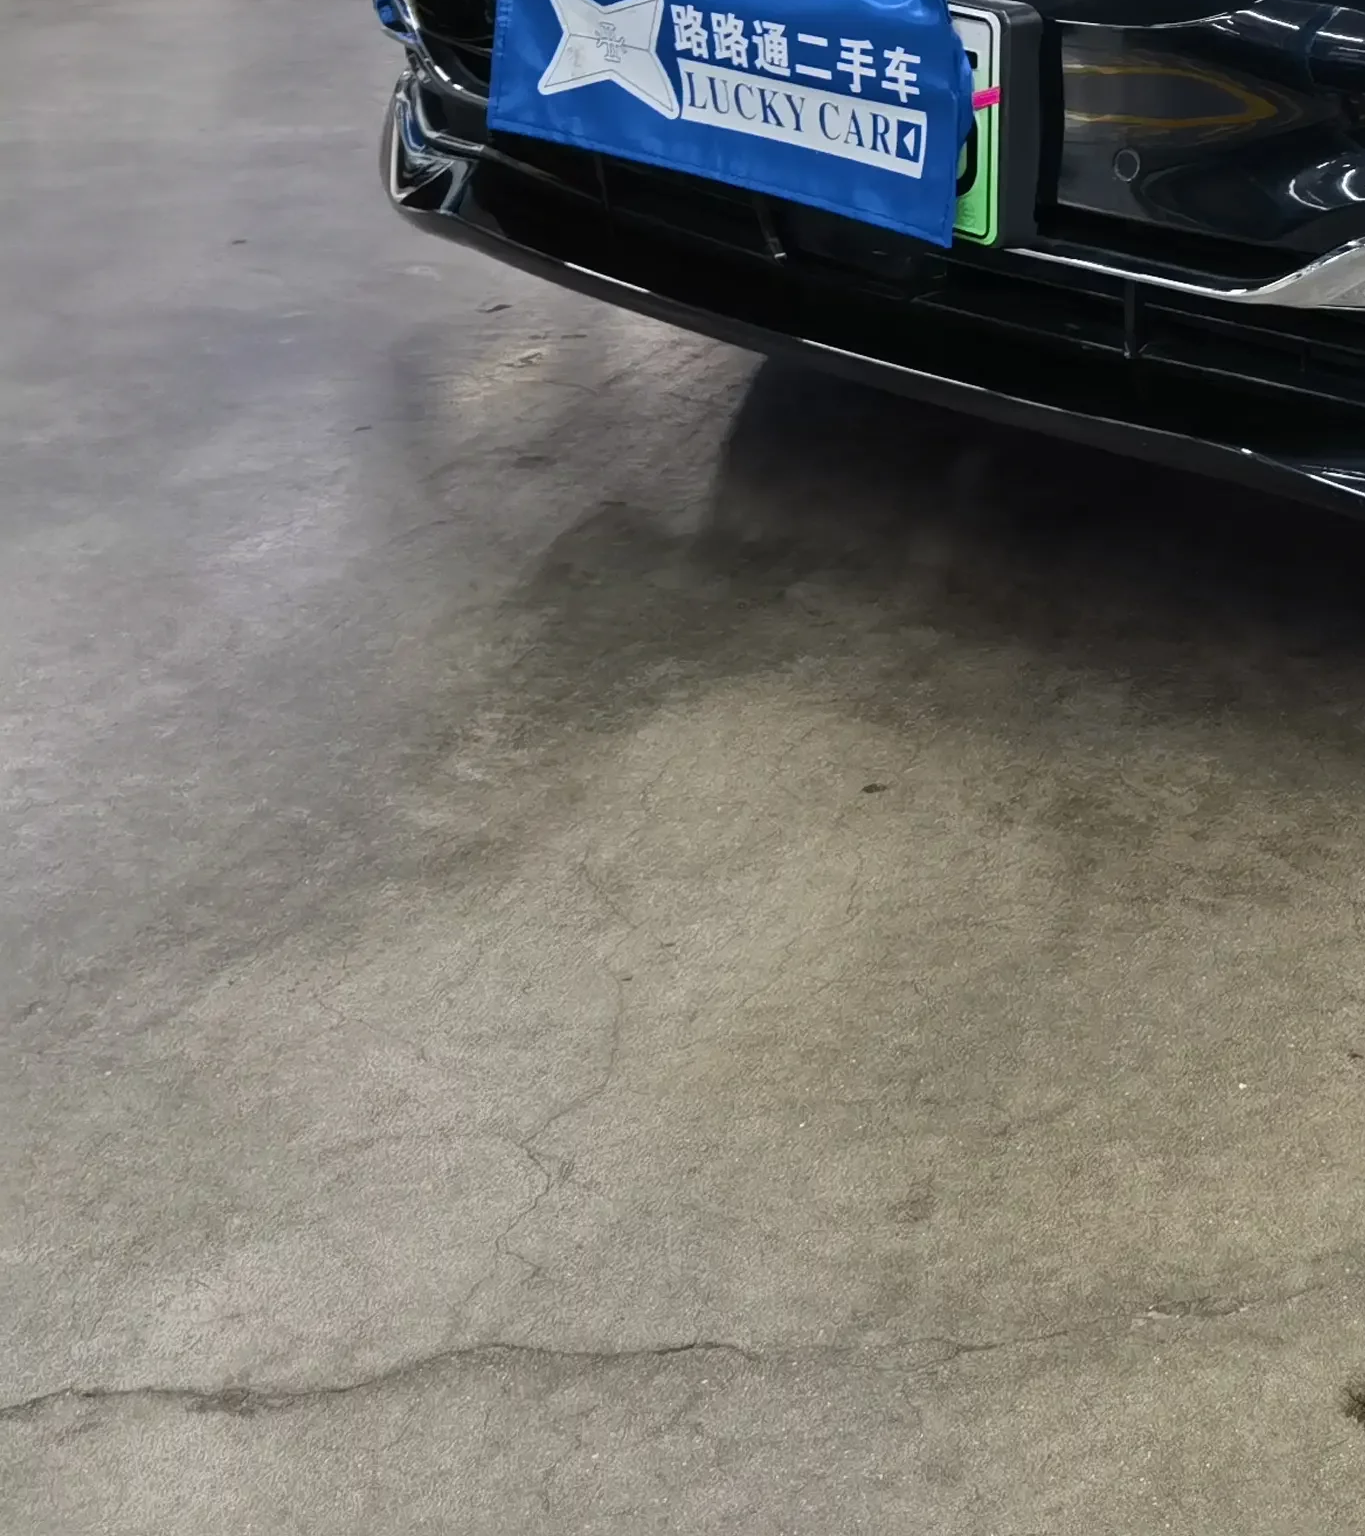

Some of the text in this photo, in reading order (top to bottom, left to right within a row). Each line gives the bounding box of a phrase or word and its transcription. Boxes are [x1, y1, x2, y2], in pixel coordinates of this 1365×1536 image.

[670, 3, 922, 102] 路路通二手车
[681, 70, 893, 154] LUCKY CAR
